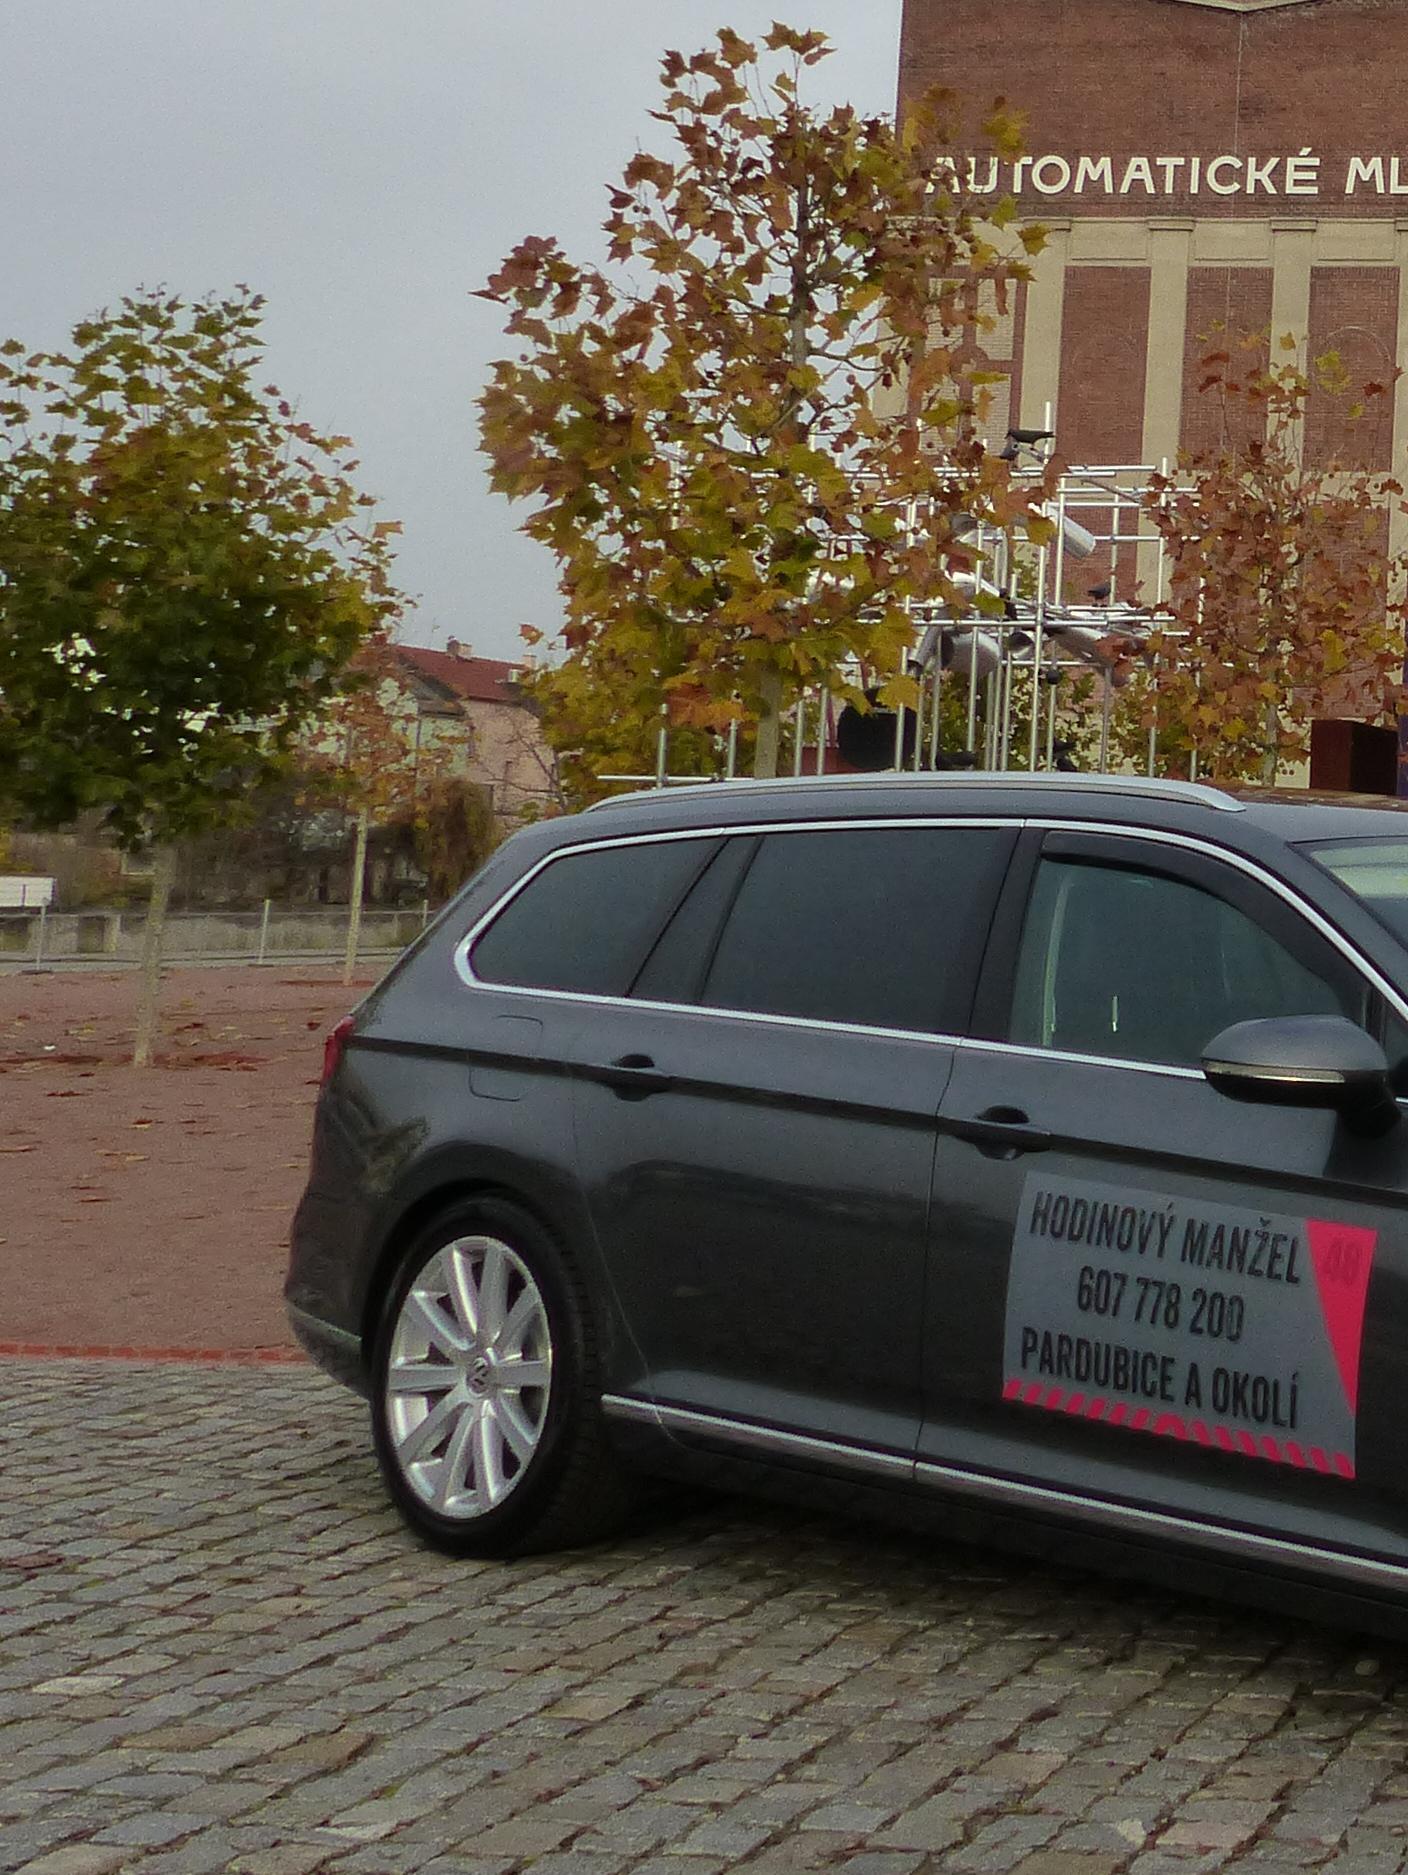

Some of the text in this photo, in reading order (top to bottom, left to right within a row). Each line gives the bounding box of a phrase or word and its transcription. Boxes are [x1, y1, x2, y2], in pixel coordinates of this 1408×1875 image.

[1030, 1191, 1300, 1284] HODINOVÝ MANŽEL
[1078, 1265, 1244, 1342] 607 778 200
[1021, 1326, 1300, 1429] PARDUBICE A OKOLÍ
